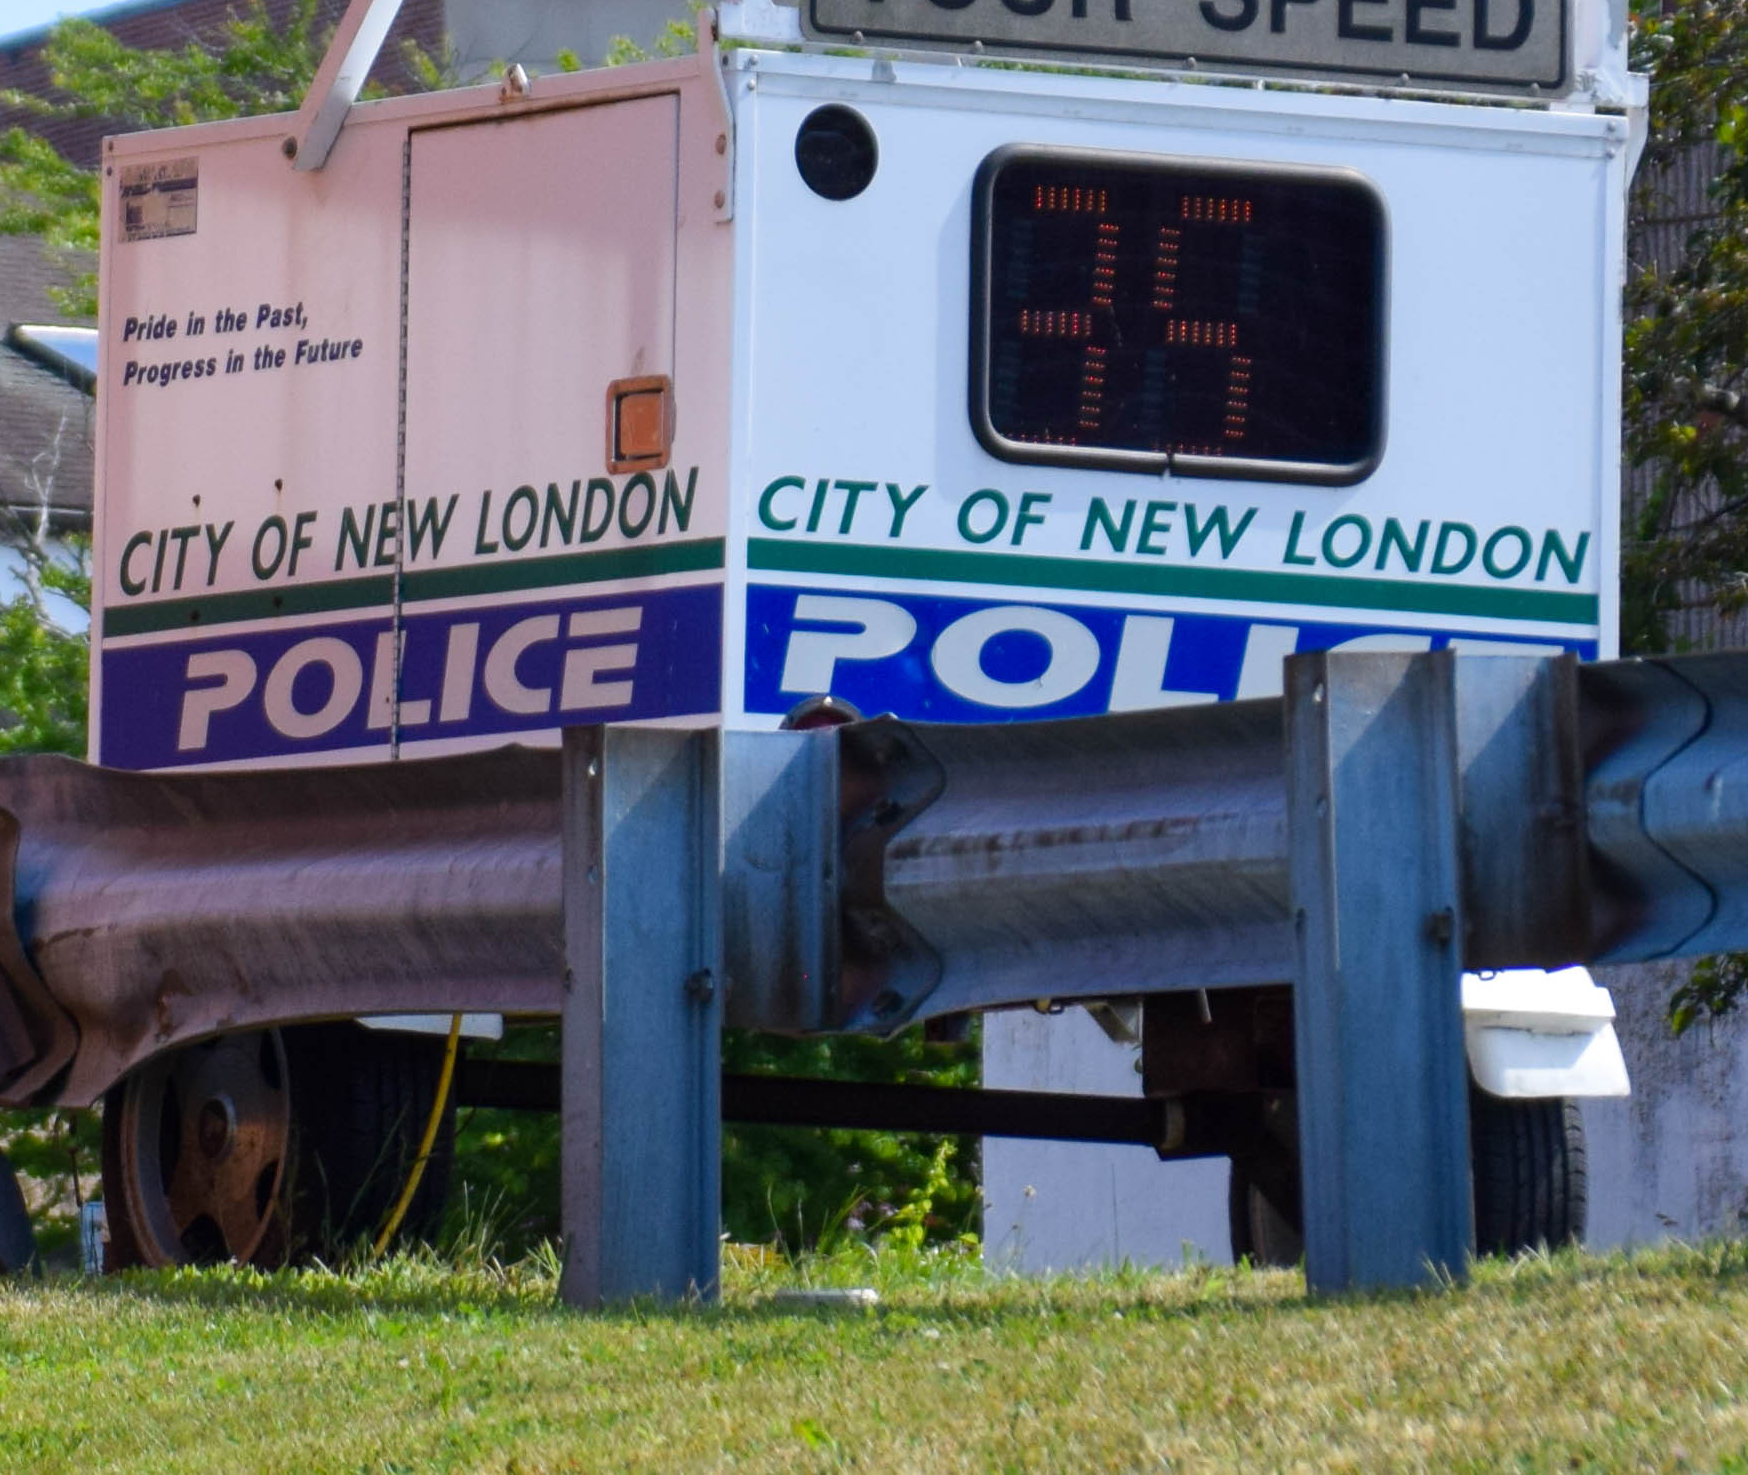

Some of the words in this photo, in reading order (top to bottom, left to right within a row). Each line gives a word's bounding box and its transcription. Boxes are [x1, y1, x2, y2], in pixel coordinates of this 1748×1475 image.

[123, 313, 178, 342] Pride
[186, 310, 205, 336] in
[215, 306, 248, 333] the
[256, 302, 308, 330] Past,
[123, 356, 217, 387] Progress
[225, 349, 245, 374] in
[254, 344, 287, 371] the
[294, 337, 363, 366] Future
[119, 520, 235, 597] CITY
[251, 510, 319, 581] OF
[334, 493, 460, 571] NEW
[474, 465, 700, 555] LONDON
[758, 474, 929, 538] CITY
[957, 487, 1052, 548] OF
[1079, 496, 1258, 560] NEW
[1283, 508, 1592, 585] LONDON
[177, 604, 644, 752] POLICE
[780, 594, 1565, 714] POLI
